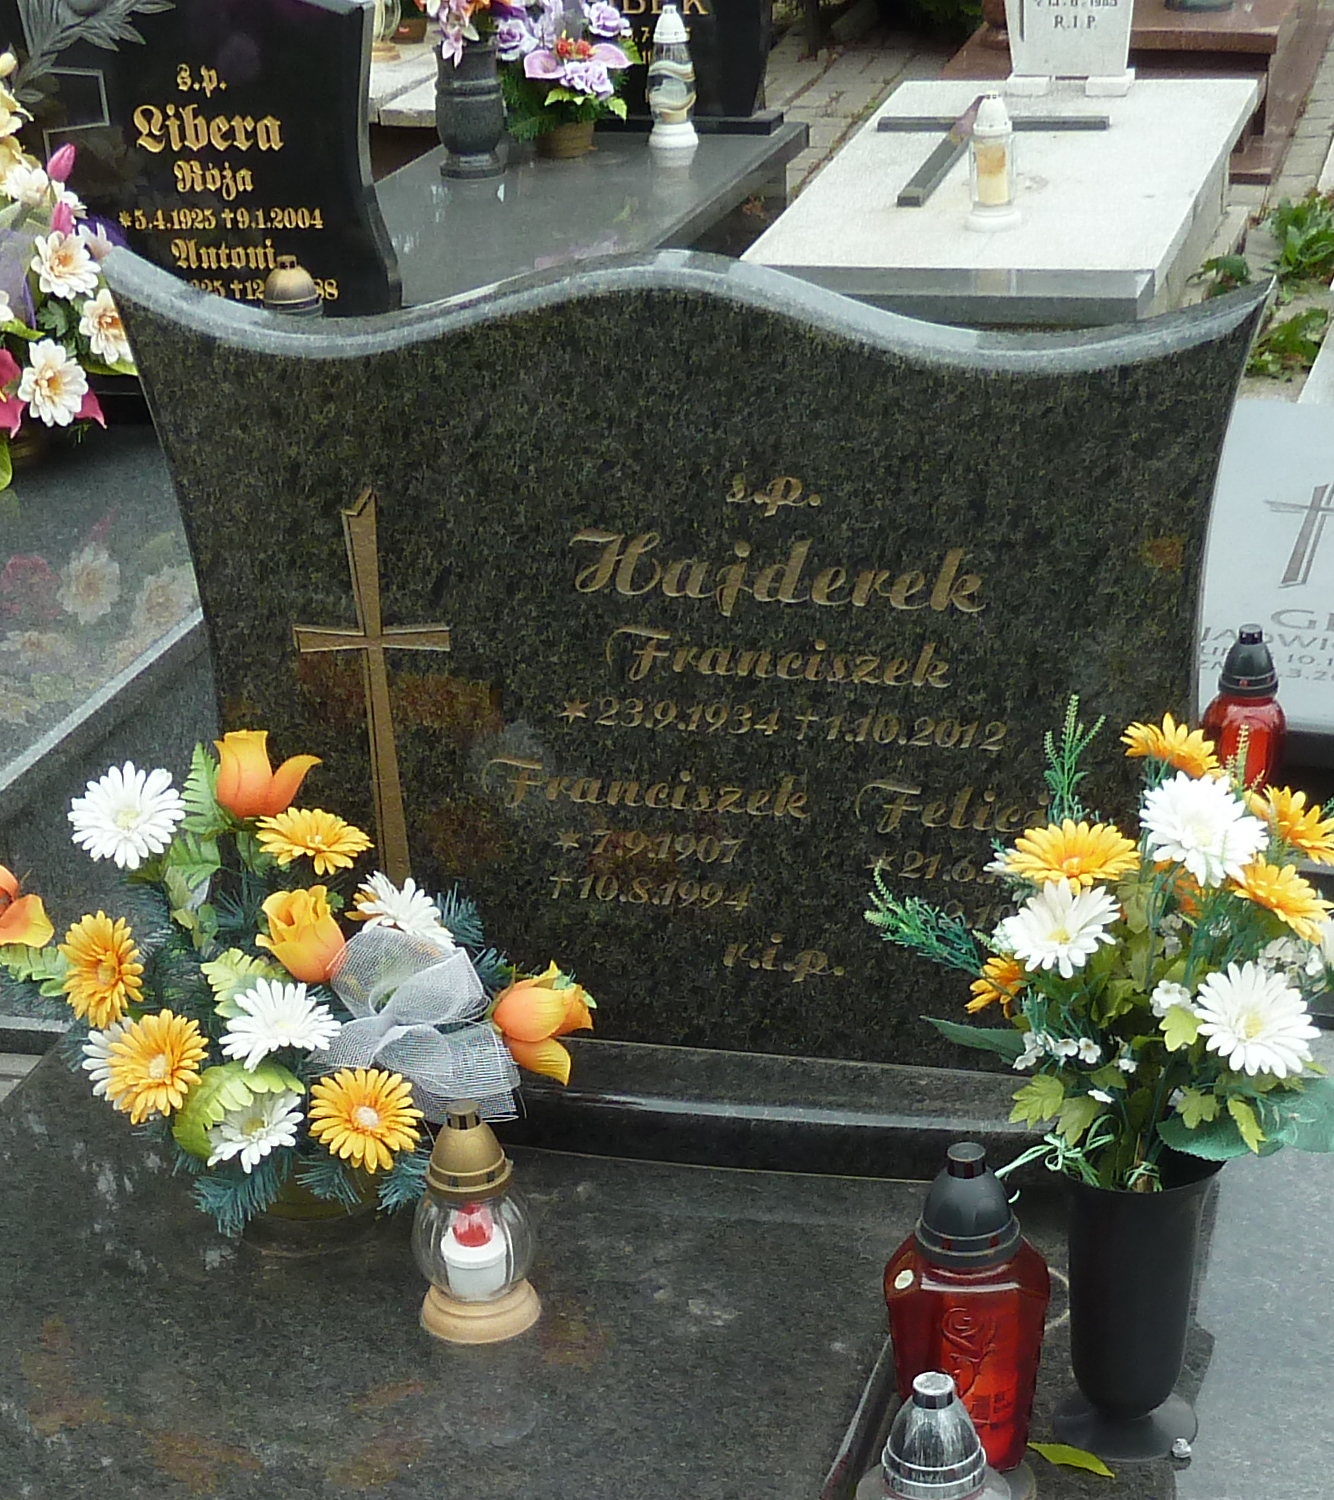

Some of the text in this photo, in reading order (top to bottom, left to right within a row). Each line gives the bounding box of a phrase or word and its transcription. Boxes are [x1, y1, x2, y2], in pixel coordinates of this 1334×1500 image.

[133, 103, 285, 153] Libera
[173, 160, 255, 201] Róża
[171, 238, 277, 270] Antoni
[569, 527, 986, 616] Hajderek
[606, 625, 952, 689] Franciszek
[480, 757, 811, 819] Franciszek
